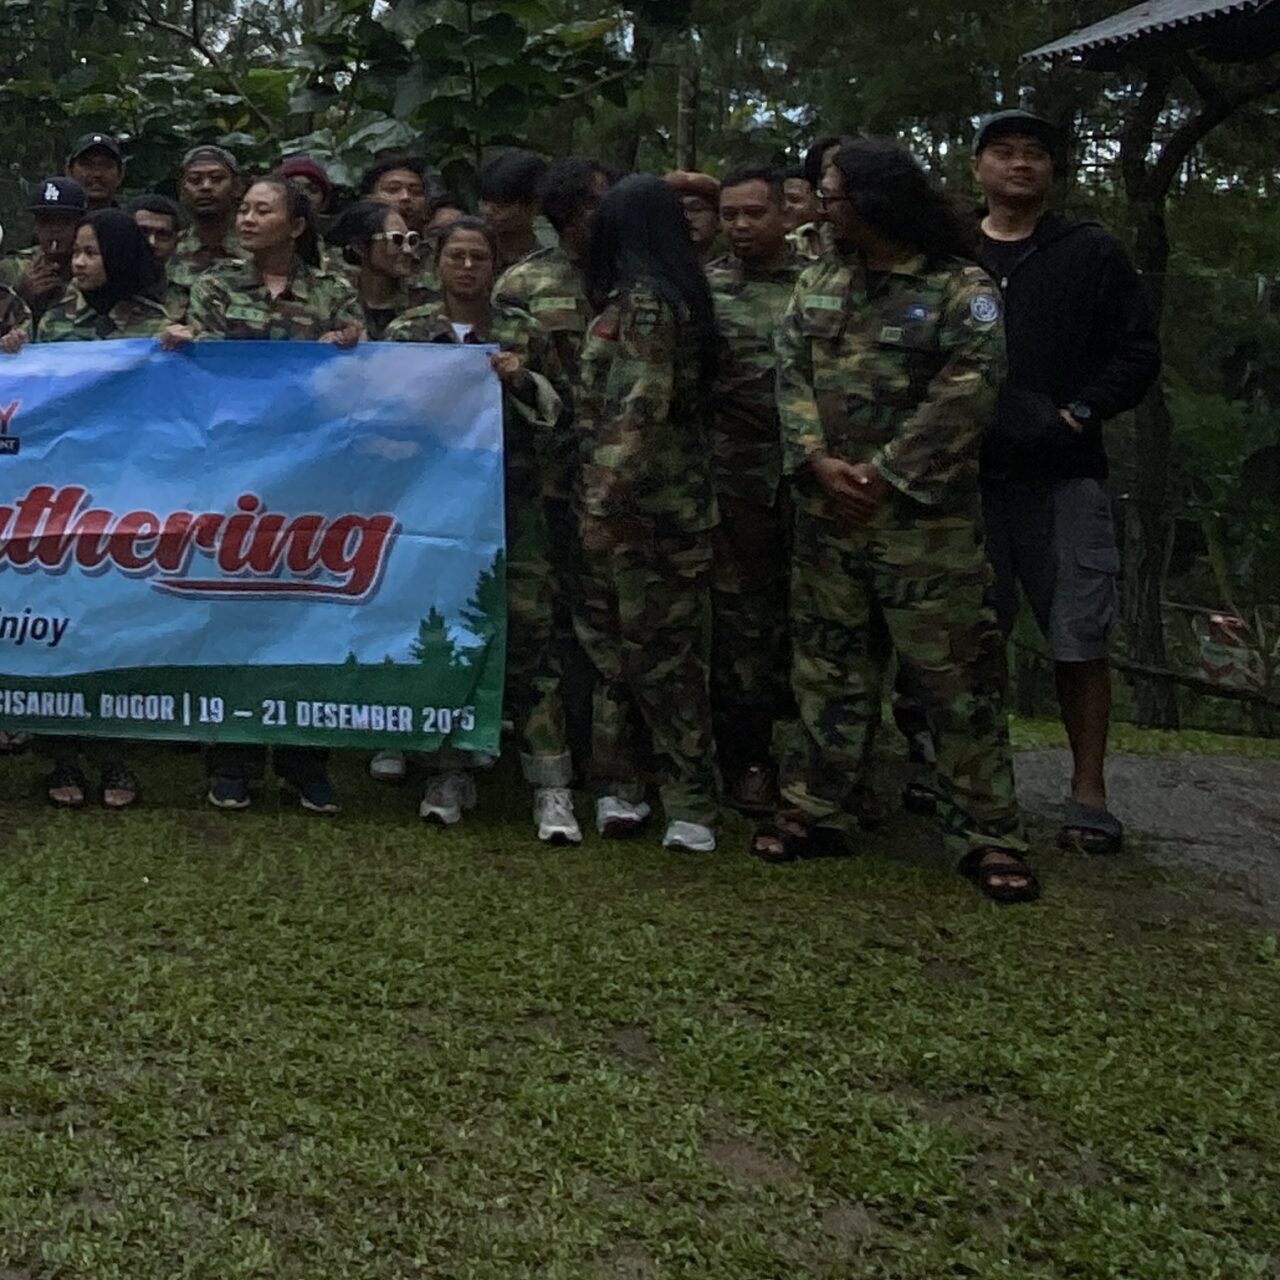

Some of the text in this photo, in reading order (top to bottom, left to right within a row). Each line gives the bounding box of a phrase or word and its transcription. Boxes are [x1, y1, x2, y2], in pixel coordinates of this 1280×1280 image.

[99, 693, 175, 721] BOGOR
[198, 696, 224, 723] 19
[261, 699, 288, 726] 21
[296, 701, 413, 733] DESEMBER
